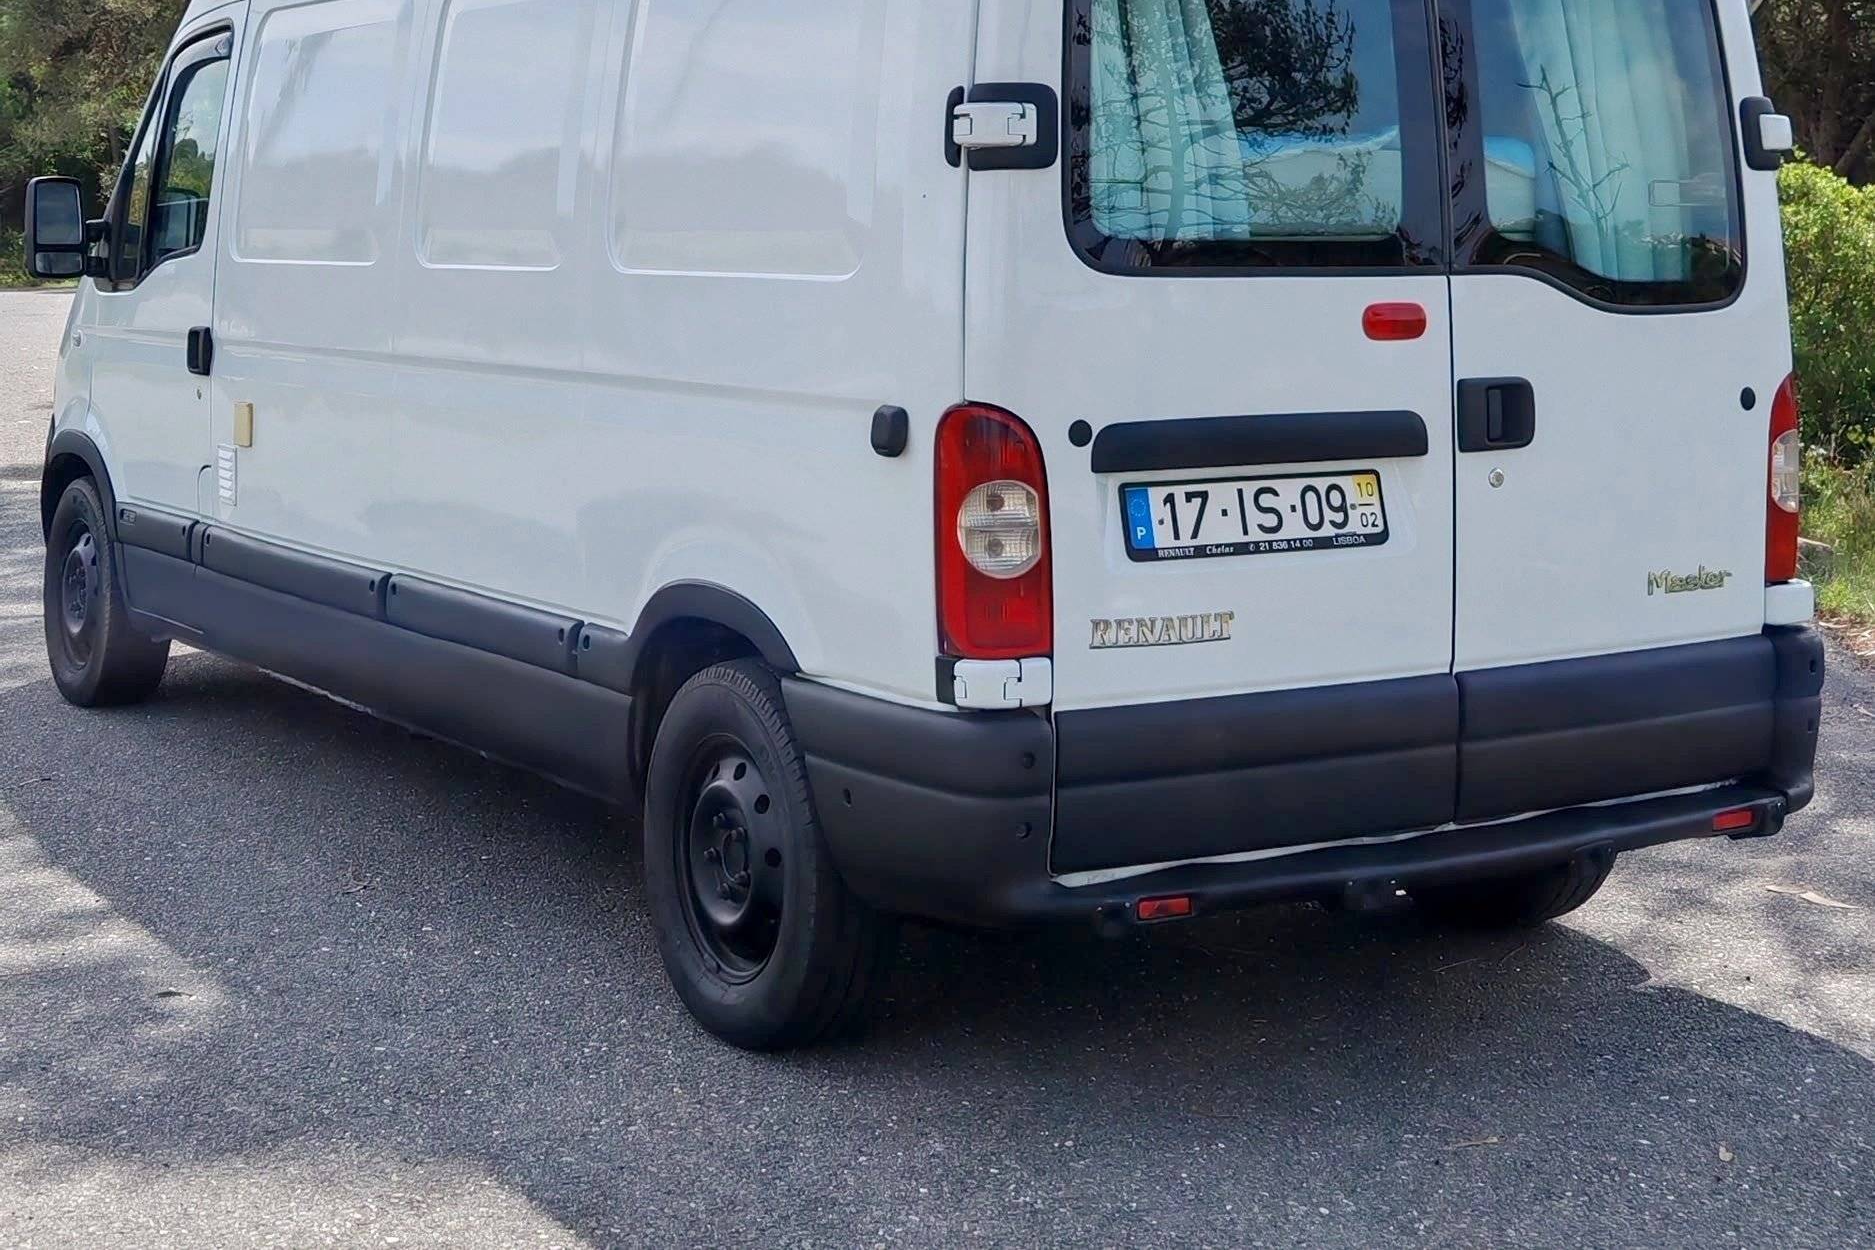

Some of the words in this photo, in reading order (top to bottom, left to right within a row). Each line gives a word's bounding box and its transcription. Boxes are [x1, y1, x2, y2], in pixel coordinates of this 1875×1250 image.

[1356, 481, 1374, 498] 10
[1360, 512, 1379, 528] 02
[1136, 527, 1146, 540] P
[1157, 547, 1195, 559] RENAULT
[1259, 542, 1270, 551] 21
[1291, 539, 1301, 549] 14
[1303, 538, 1314, 548] 00
[1332, 535, 1366, 546] LISBOA
[1647, 563, 1733, 596] Master
[1088, 610, 1235, 650] RENAULT
